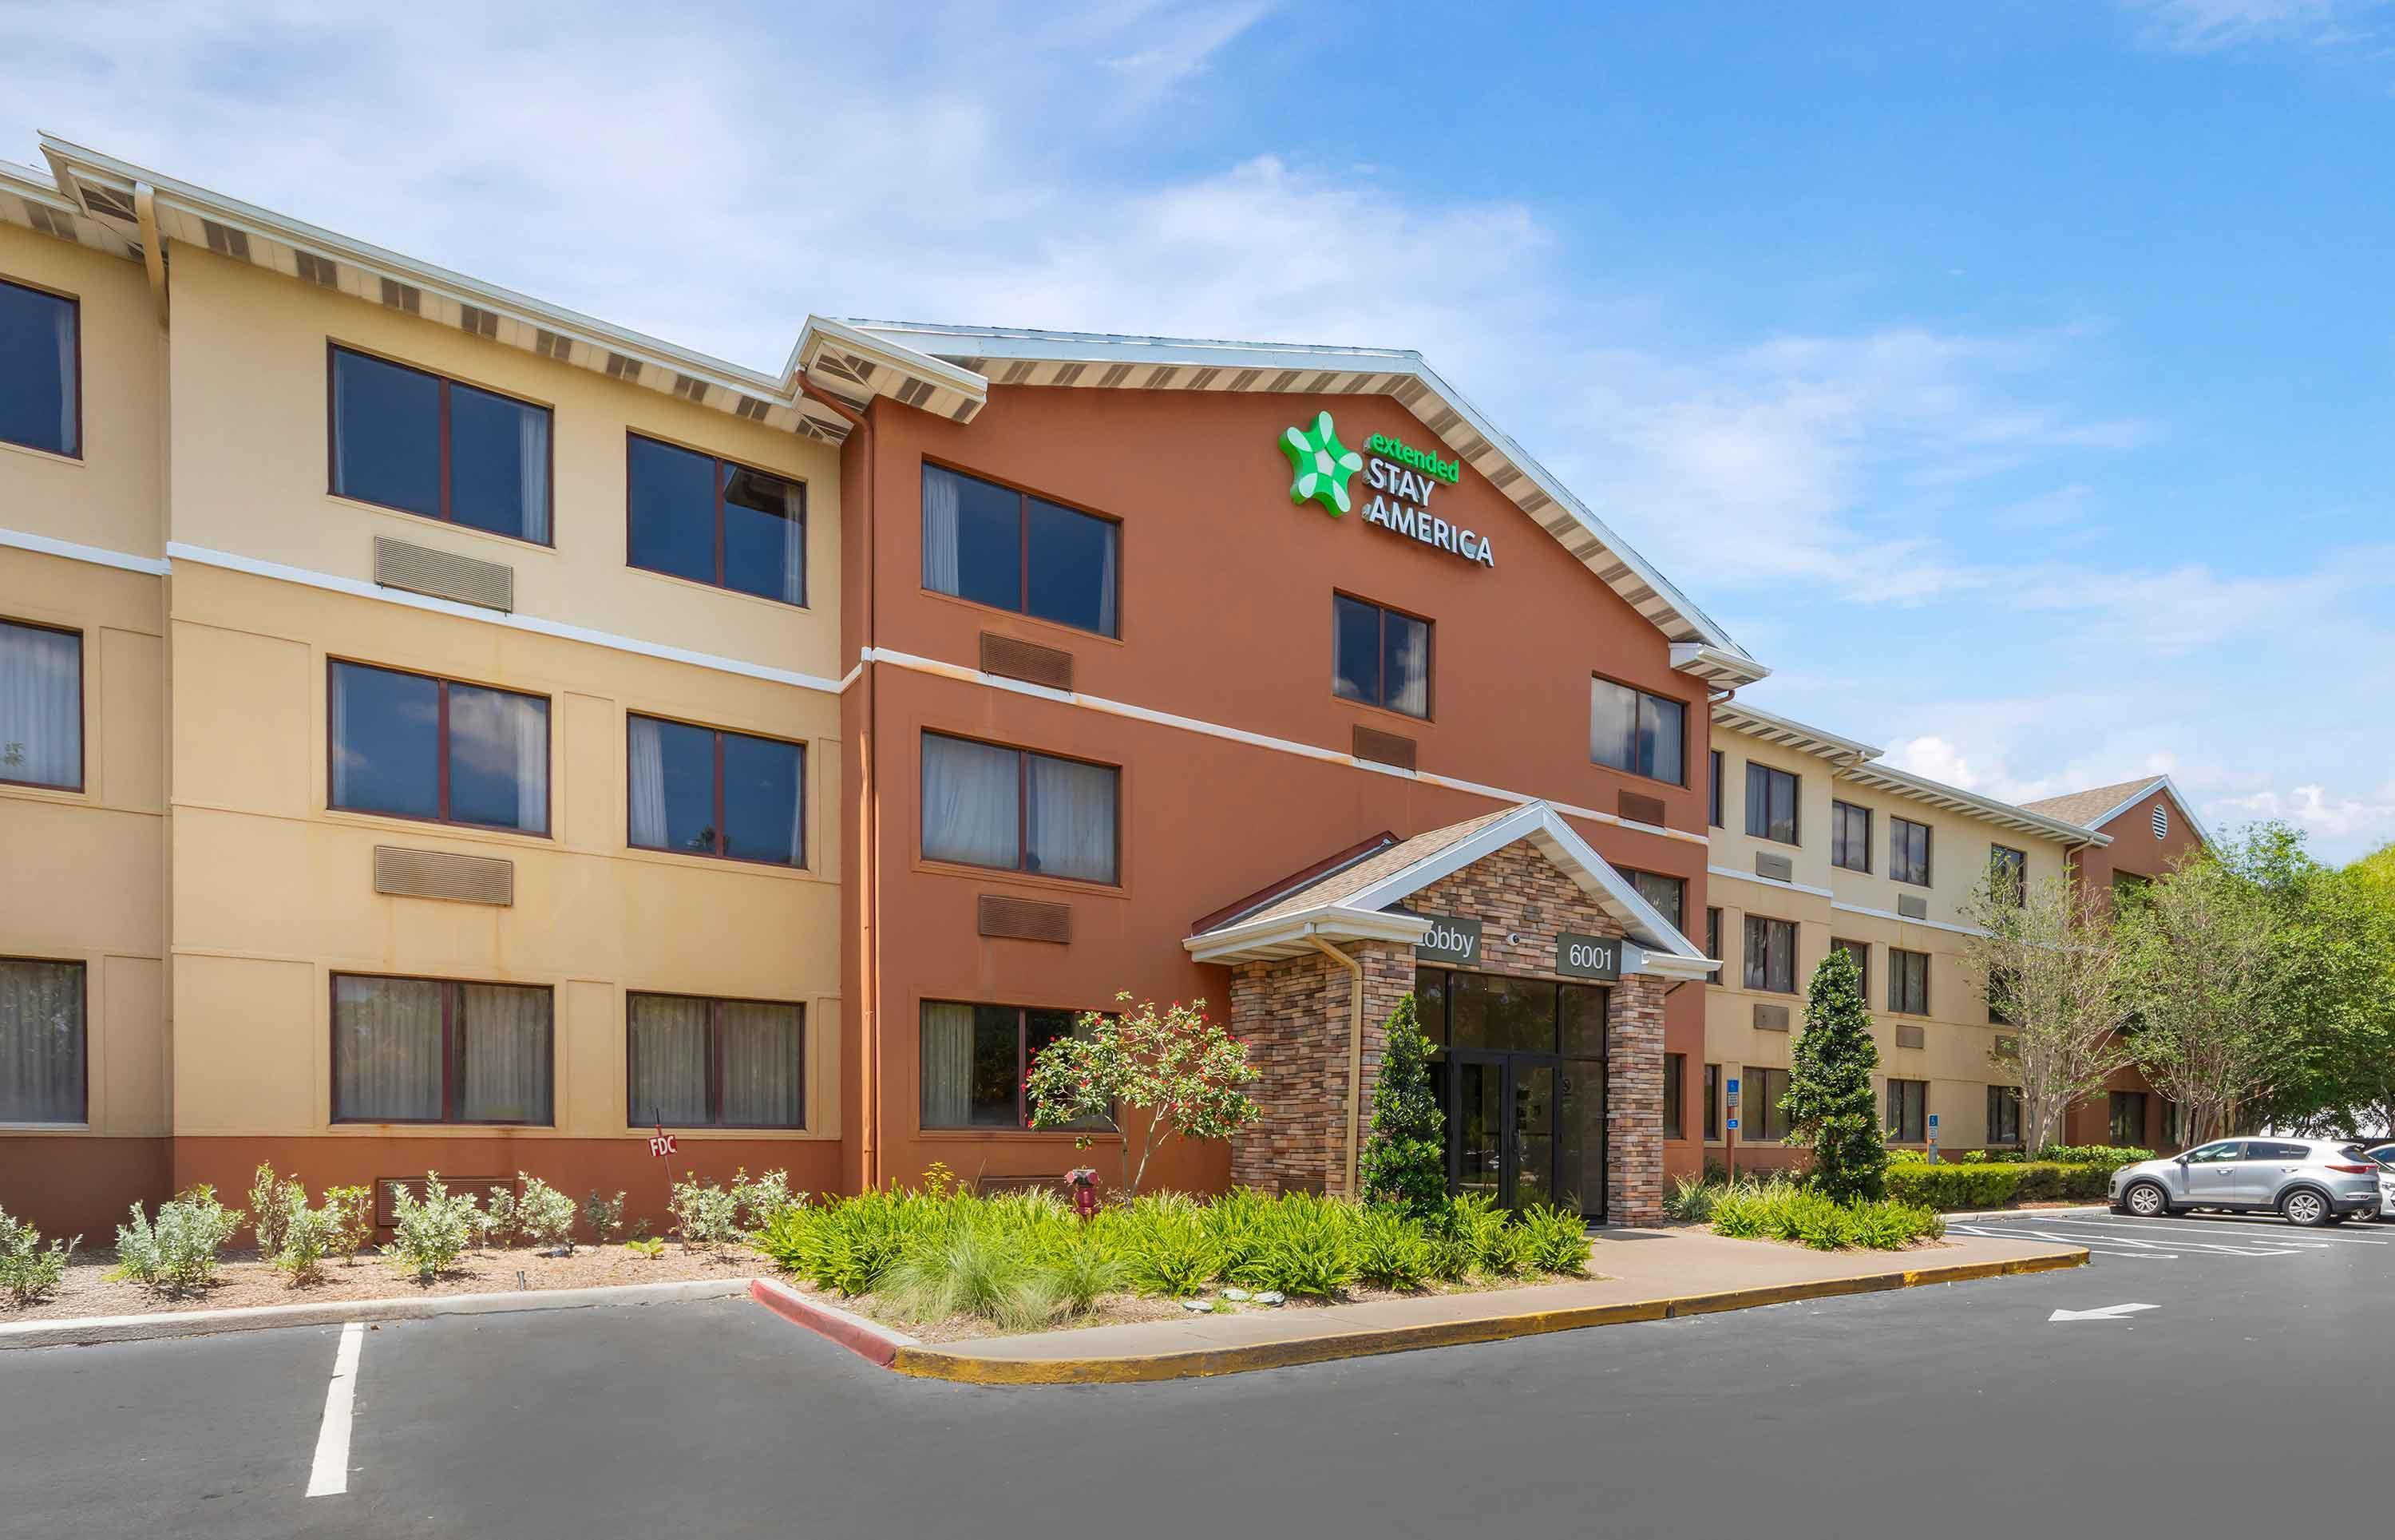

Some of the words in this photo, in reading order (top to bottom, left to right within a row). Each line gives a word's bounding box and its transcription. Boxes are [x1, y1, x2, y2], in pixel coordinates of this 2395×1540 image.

[1369, 433, 1459, 483] extended
[1369, 457, 1435, 507] STAY
[1369, 494, 1494, 568] AMERICA
[1418, 925, 1474, 958] obby
[1570, 944, 1611, 971] 6001
[650, 1135, 677, 1156] FDC
